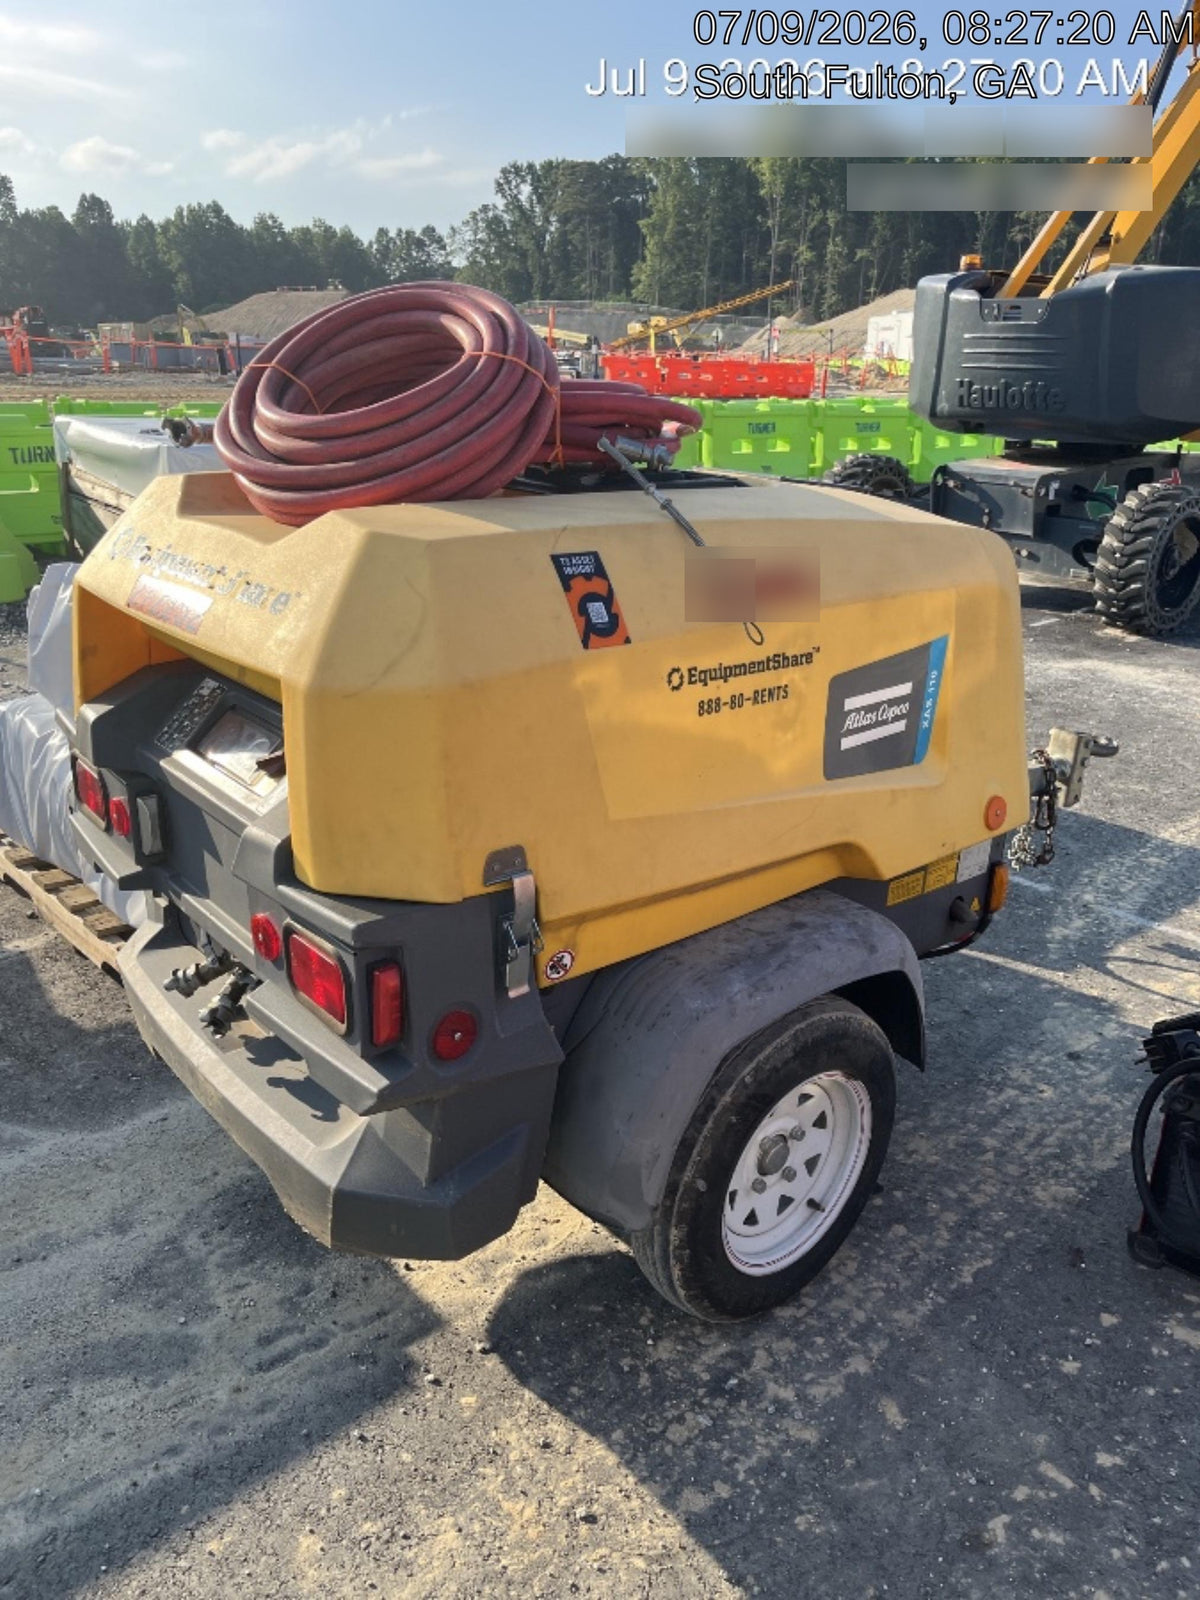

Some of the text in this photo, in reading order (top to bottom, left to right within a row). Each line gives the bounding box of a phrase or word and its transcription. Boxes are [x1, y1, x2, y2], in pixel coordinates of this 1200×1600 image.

[955, 378, 1066, 411] Haulotte
[8, 446, 56, 464] TURN
[697, 684, 790, 717] 888-80-RENTS
[841, 702, 910, 733] Atlas Copco
